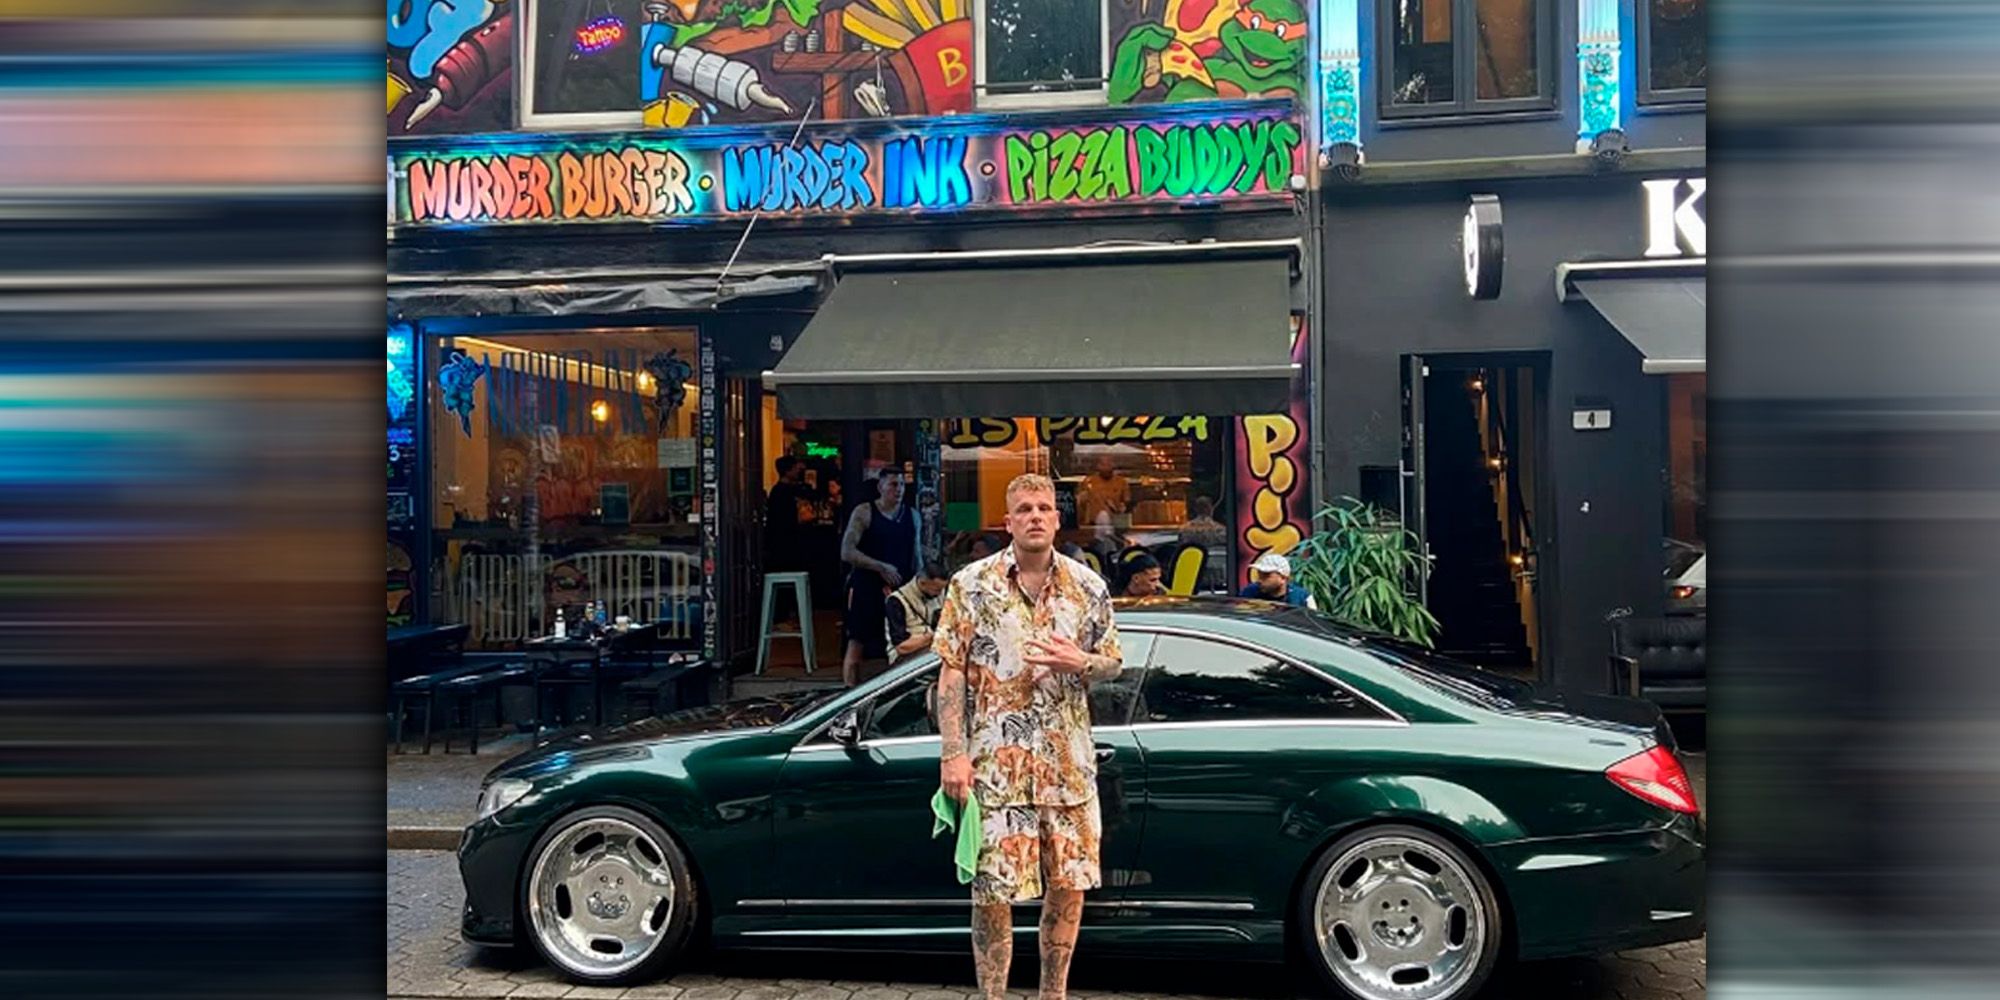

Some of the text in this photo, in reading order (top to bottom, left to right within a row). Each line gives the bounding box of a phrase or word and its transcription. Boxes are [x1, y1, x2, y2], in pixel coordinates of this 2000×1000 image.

[577, 26, 621, 46] Tattoo
[938, 47, 968, 87] B
[409, 156, 554, 221] MURDER
[559, 147, 695, 218] BURGER
[724, 138, 876, 213] MURDER
[883, 135, 973, 208] INK
[1134, 119, 1300, 196] BUDDYS
[1587, 411, 1596, 427] 4
